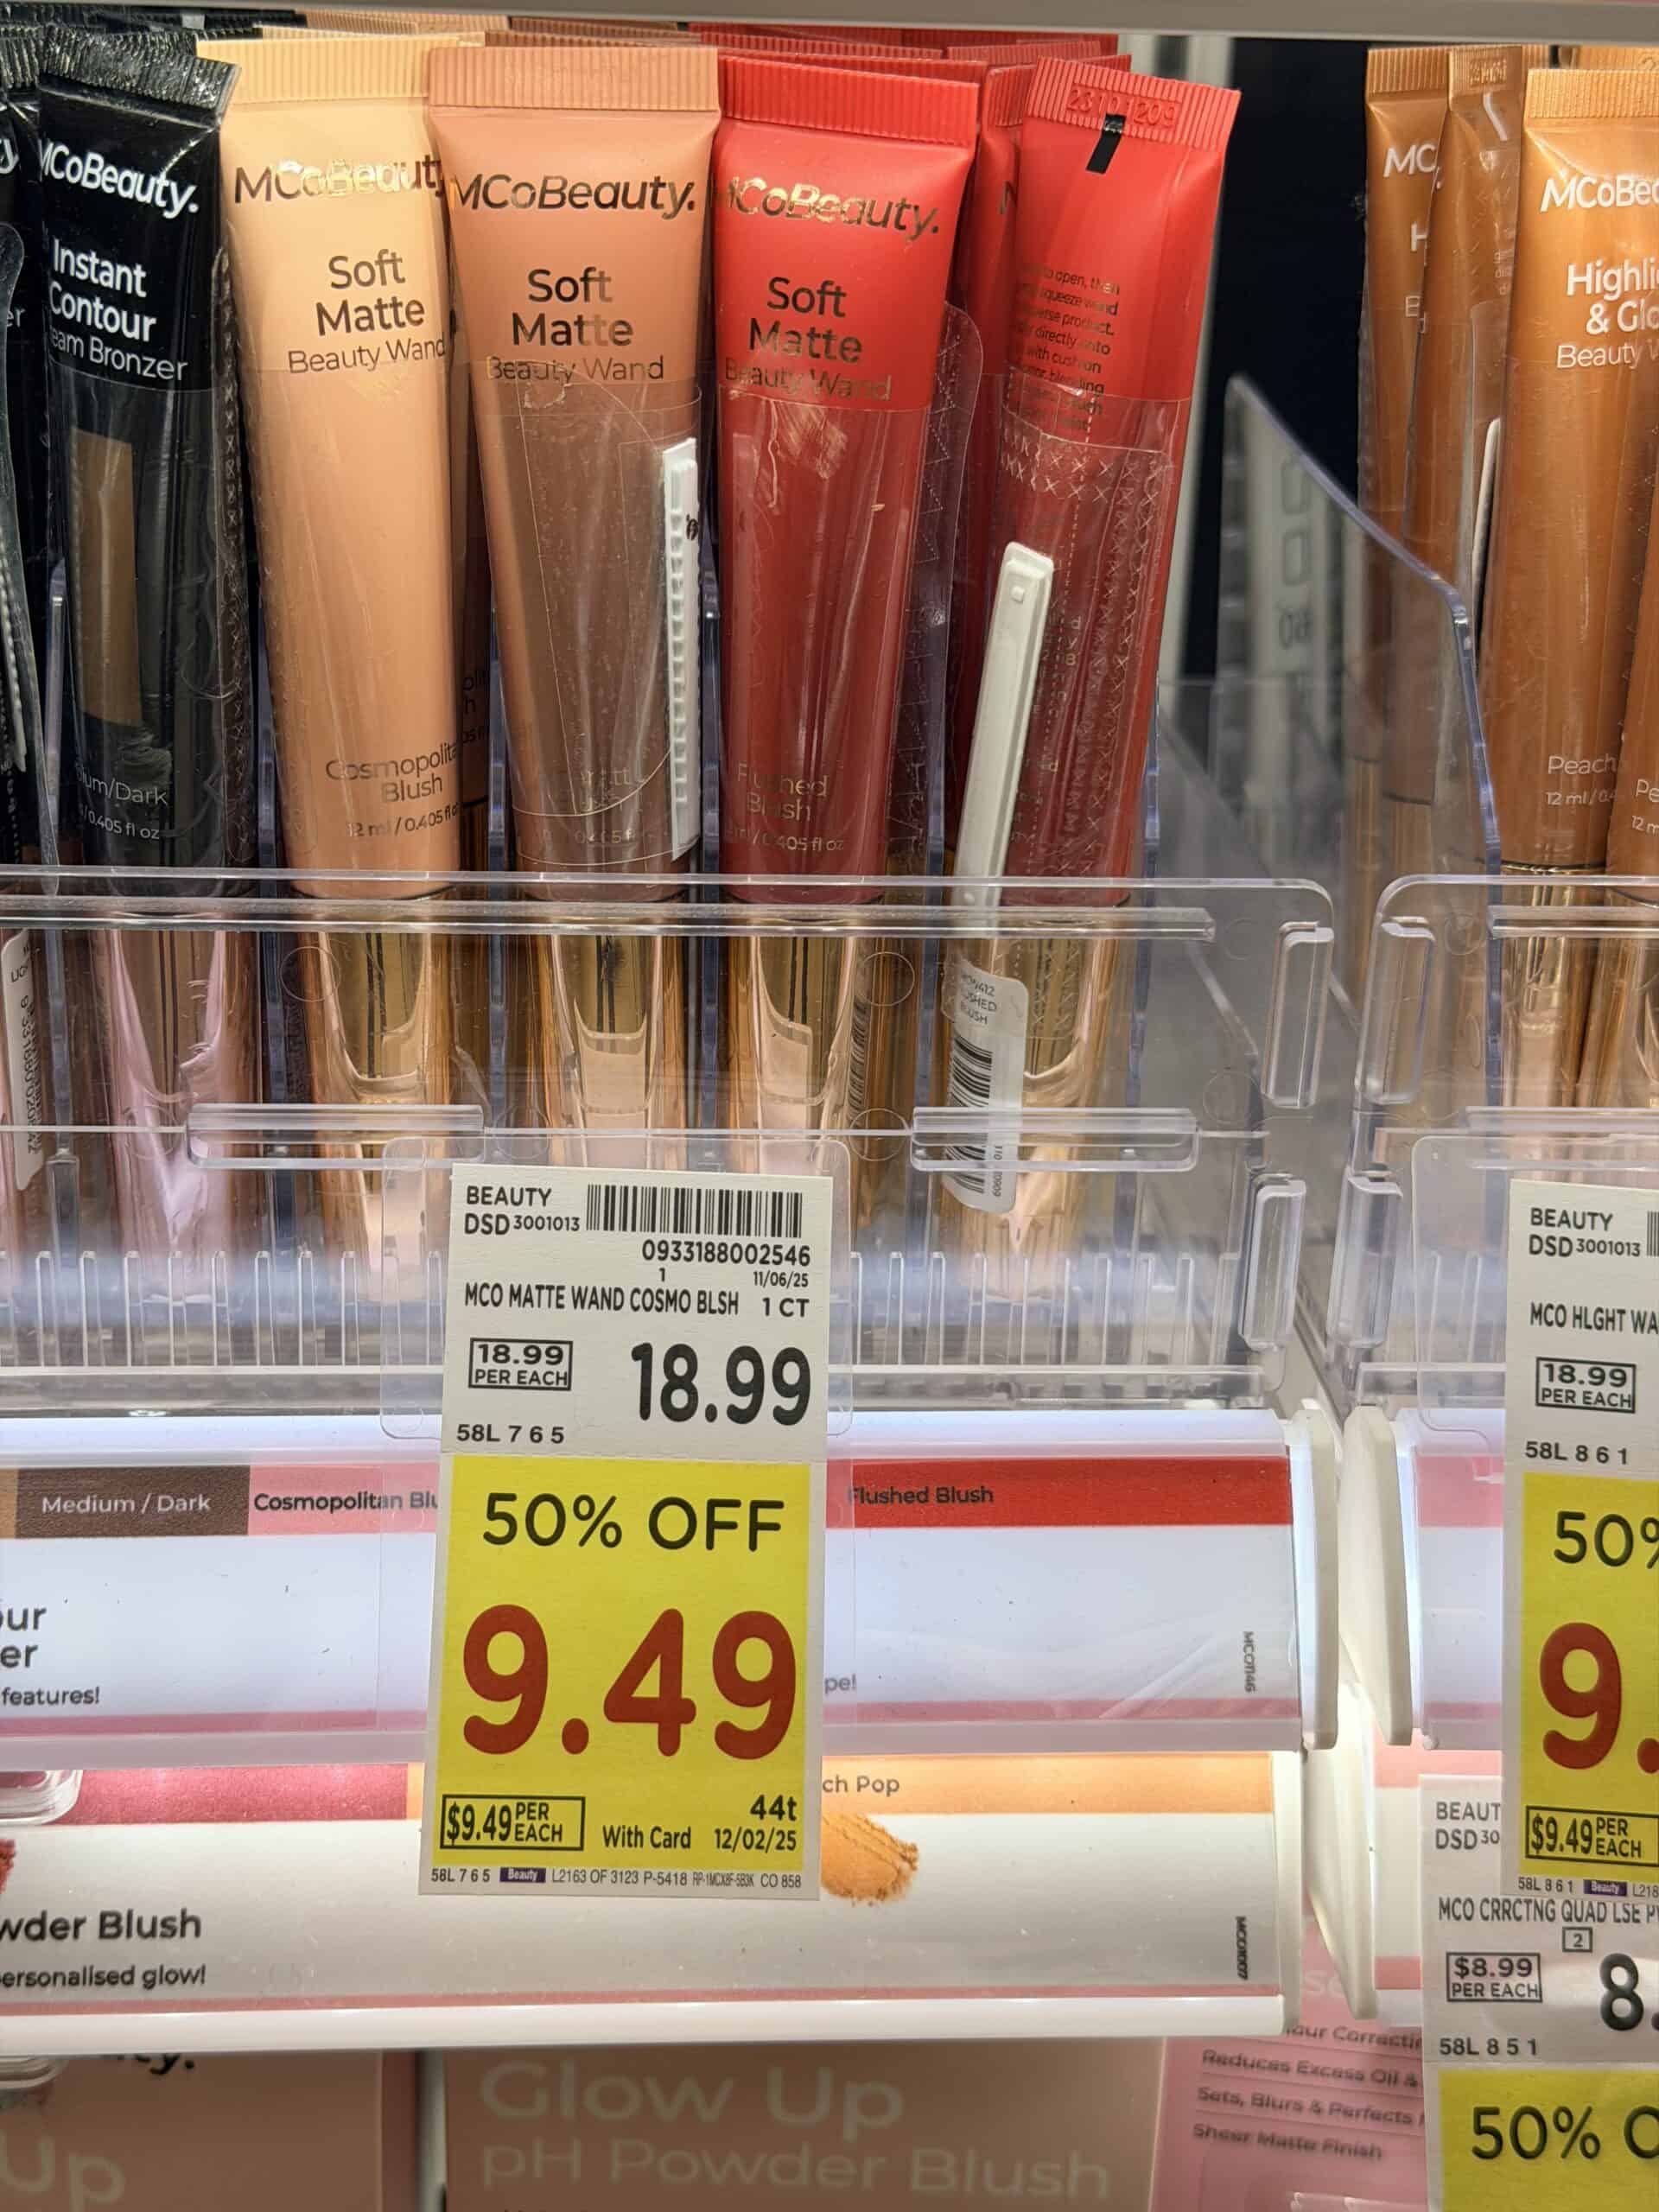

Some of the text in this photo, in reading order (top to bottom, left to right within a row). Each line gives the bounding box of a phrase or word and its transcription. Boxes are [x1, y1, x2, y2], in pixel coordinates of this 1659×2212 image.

[39, 140, 200, 219] MCoBeauty.
[450, 173, 695, 219] MCoBeauty.
[53, 238, 147, 298] Instant
[328, 249, 405, 289] Soft
[528, 268, 612, 302] Soft
[767, 277, 848, 318] Soft
[48, 283, 156, 342] Contour
[316, 297, 425, 336] Matte
[1586, 303, 1609, 334] &
[512, 313, 633, 346] Matte
[749, 318, 862, 364] Matte
[49, 326, 188, 381] eam Bronzer
[289, 337, 446, 373] Beauty Wand
[1556, 342, 1641, 370] Beauty
[486, 355, 664, 384] Beauty Wand
[725, 357, 891, 401] Beauty Wand
[1548, 753, 1617, 774] Peach
[382, 773, 442, 802] Blush
[1546, 791, 1562, 805] 12
[88, 810, 122, 834] 0.405
[140, 828, 160, 840] oz
[405, 809, 443, 831] 0.405
[467, 1185, 552, 1207] BEAUTY
[464, 1212, 581, 1236] DSD 3001013
[1530, 1207, 1613, 1231] BEAUTY
[642, 1239, 810, 1268] 0933188002546
[1529, 1234, 1641, 1257] DSD 3001013
[658, 1268, 809, 1288] 1 11/06/25
[464, 1282, 810, 1318] MCO MATTE WAND COSMO BLSH 1 CT
[1530, 1301, 1567, 1328] MCO
[1573, 1306, 1626, 1332] HLGHT
[478, 1344, 564, 1366] 18.99
[474, 1368, 568, 1388] PER EACH
[631, 1342, 811, 1426] 18.99
[1544, 1363, 1627, 1388] 18.99
[1541, 1387, 1631, 1408] PER EACH
[456, 1423, 501, 1442] 58L
[1525, 1441, 1567, 1460] 58L
[41, 1494, 212, 1515] Medium / Dark
[254, 1491, 404, 1514] Cosmopolitan
[849, 1484, 994, 1505] Flushed Blush
[483, 1492, 785, 1552] 50% OFF
[463, 1604, 797, 1761] 9.49
[2, 1687, 100, 1707] features!
[855, 1776, 899, 1799] Pop
[750, 1795, 798, 1821] 44t
[446, 1801, 550, 1847] $9.49 PER
[514, 1823, 563, 1842] EACH
[1531, 1813, 1592, 1854] $9.49
[1595, 1817, 1628, 1837] PER
[602, 1826, 798, 1853] With Card 12/02/25
[1435, 1828, 1478, 1850] DSD
[1595, 1839, 1642, 1859] EACH
[431, 1868, 454, 1884] 58L
[507, 1868, 539, 1884] Beauty
[552, 1869, 586, 1885] L2163
[589, 1870, 607, 1885] OF
[610, 1870, 639, 1885] 3123
[644, 1872, 687, 1887] P-5418
[760, 1873, 777, 1888] CO
[780, 1874, 802, 1889] 858
[1518, 1877, 1540, 1891] 58L
[99, 1908, 202, 1940] Blush
[1439, 1897, 1474, 1921] MCO
[1479, 1897, 1555, 1923] CRRCTNG
[1561, 1899, 1607, 1923] QUAD
[1612, 1902, 1641, 1924] LSE
[1573, 1934, 1584, 1948] 2
[142, 1964, 207, 1991] glow!
[1454, 1956, 1532, 1980] $8.99
[1452, 1983, 1538, 1999] PER EACH
[1440, 2037, 1479, 2056] 58L
[1203, 2049, 1291, 2074] Reduces
[1297, 2059, 1365, 2082] Excess
[1371, 2069, 1398, 2087] Oil
[480, 2060, 904, 2142] Glow Up
[1250, 2092, 1304, 2113] Blurs
[1329, 2101, 1413, 2125] Perfects
[1193, 2123, 1383, 2162] Sheer Matte Finish
[1471, 2105, 1600, 2160] 50%
[483, 2138, 1110, 2201] pH Powder Blush
